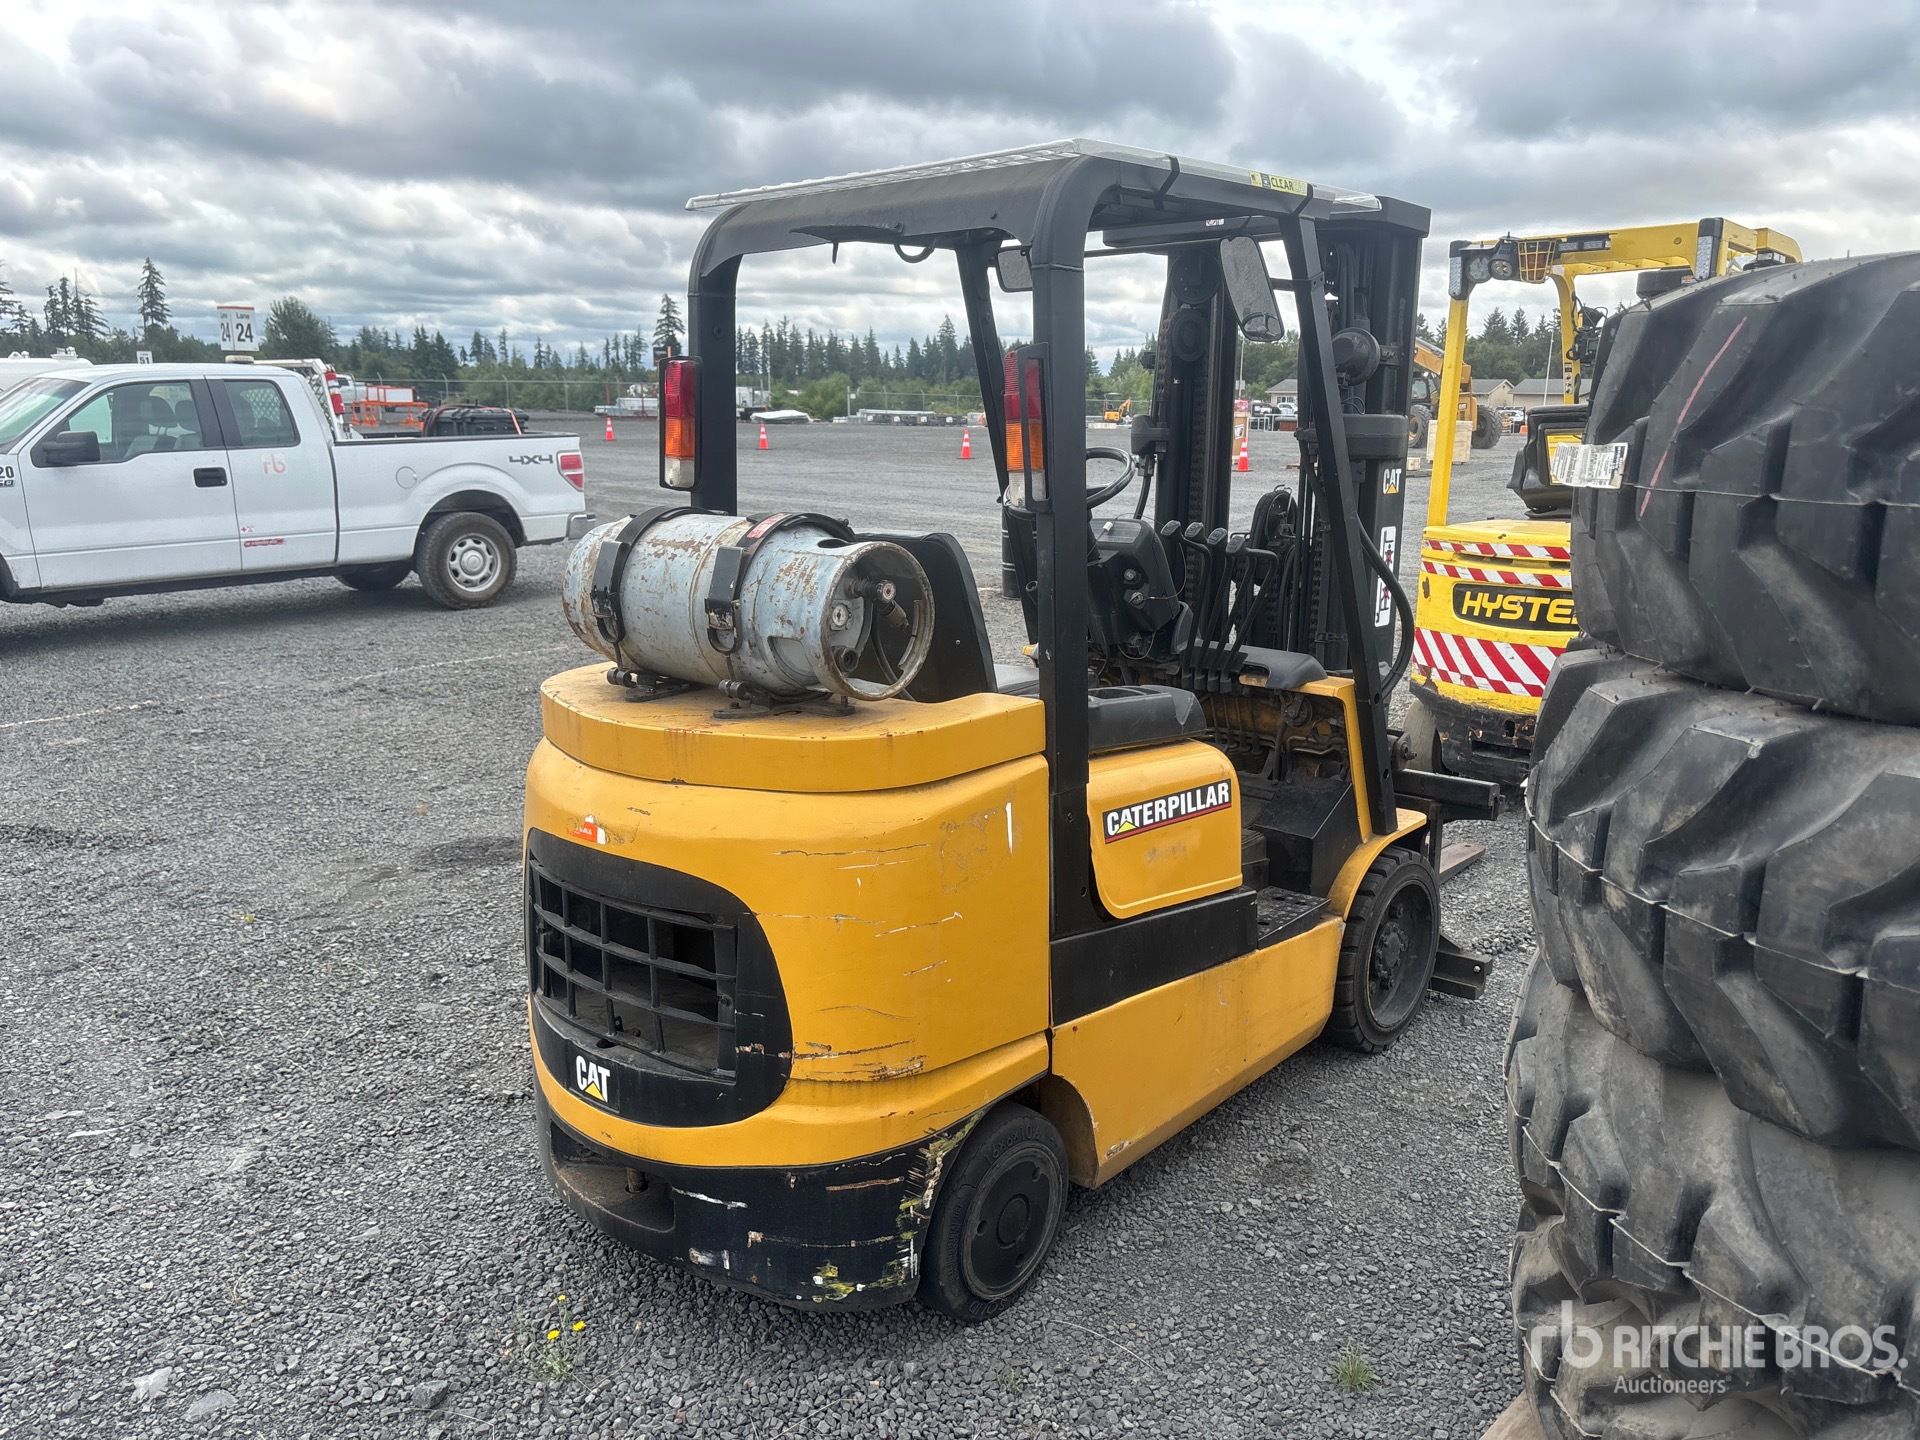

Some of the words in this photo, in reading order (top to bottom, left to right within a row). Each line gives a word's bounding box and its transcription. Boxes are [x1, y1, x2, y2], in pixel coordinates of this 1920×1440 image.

[221, 322, 231, 342] 24
[236, 323, 253, 342] 24
[1383, 469, 1402, 494] CAT
[1461, 591, 1577, 625] HYSTE
[1106, 782, 1229, 836] CATERPILLAR
[576, 1055, 610, 1103] CAT
